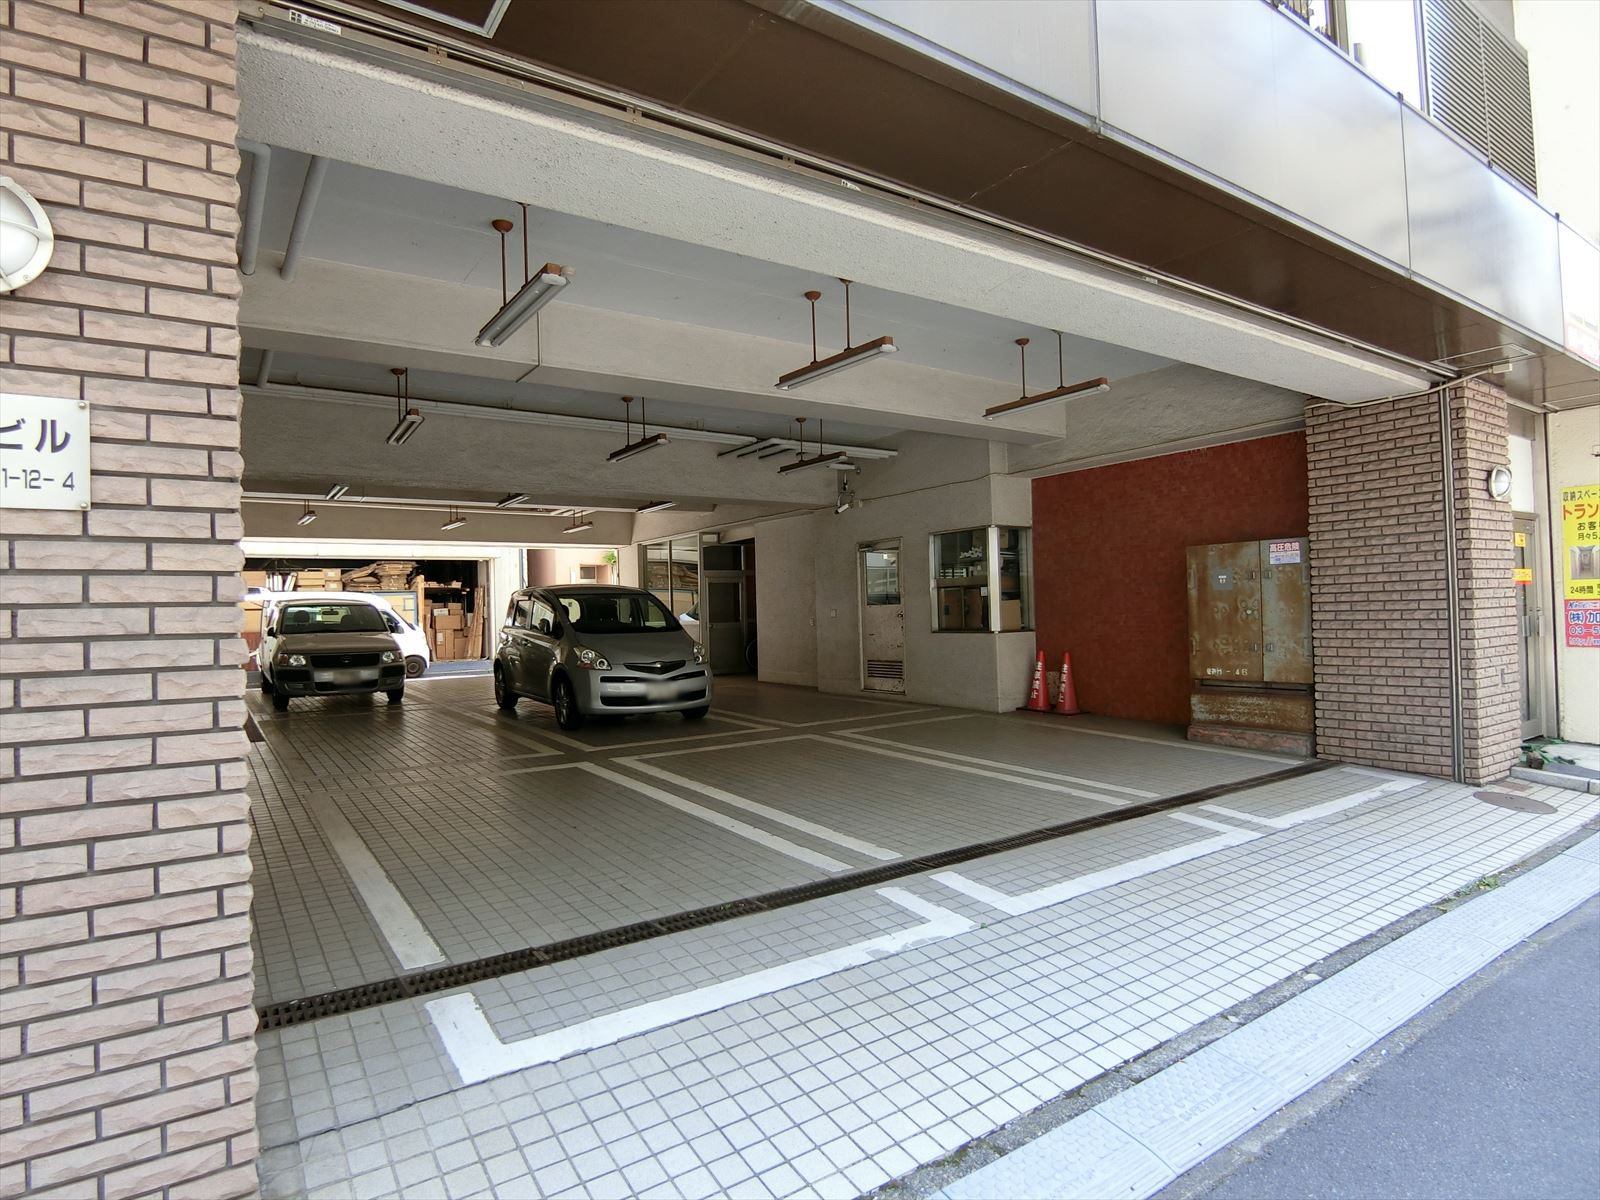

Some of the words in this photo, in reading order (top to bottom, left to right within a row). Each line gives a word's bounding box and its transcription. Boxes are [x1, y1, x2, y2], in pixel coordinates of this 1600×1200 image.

[0, 418, 71, 453] ビル
[1563, 489, 1600, 502] 収納スペー
[1563, 503, 1599, 520] トラン
[1577, 521, 1600, 531] お客
[1577, 531, 1600, 541] 月々5
